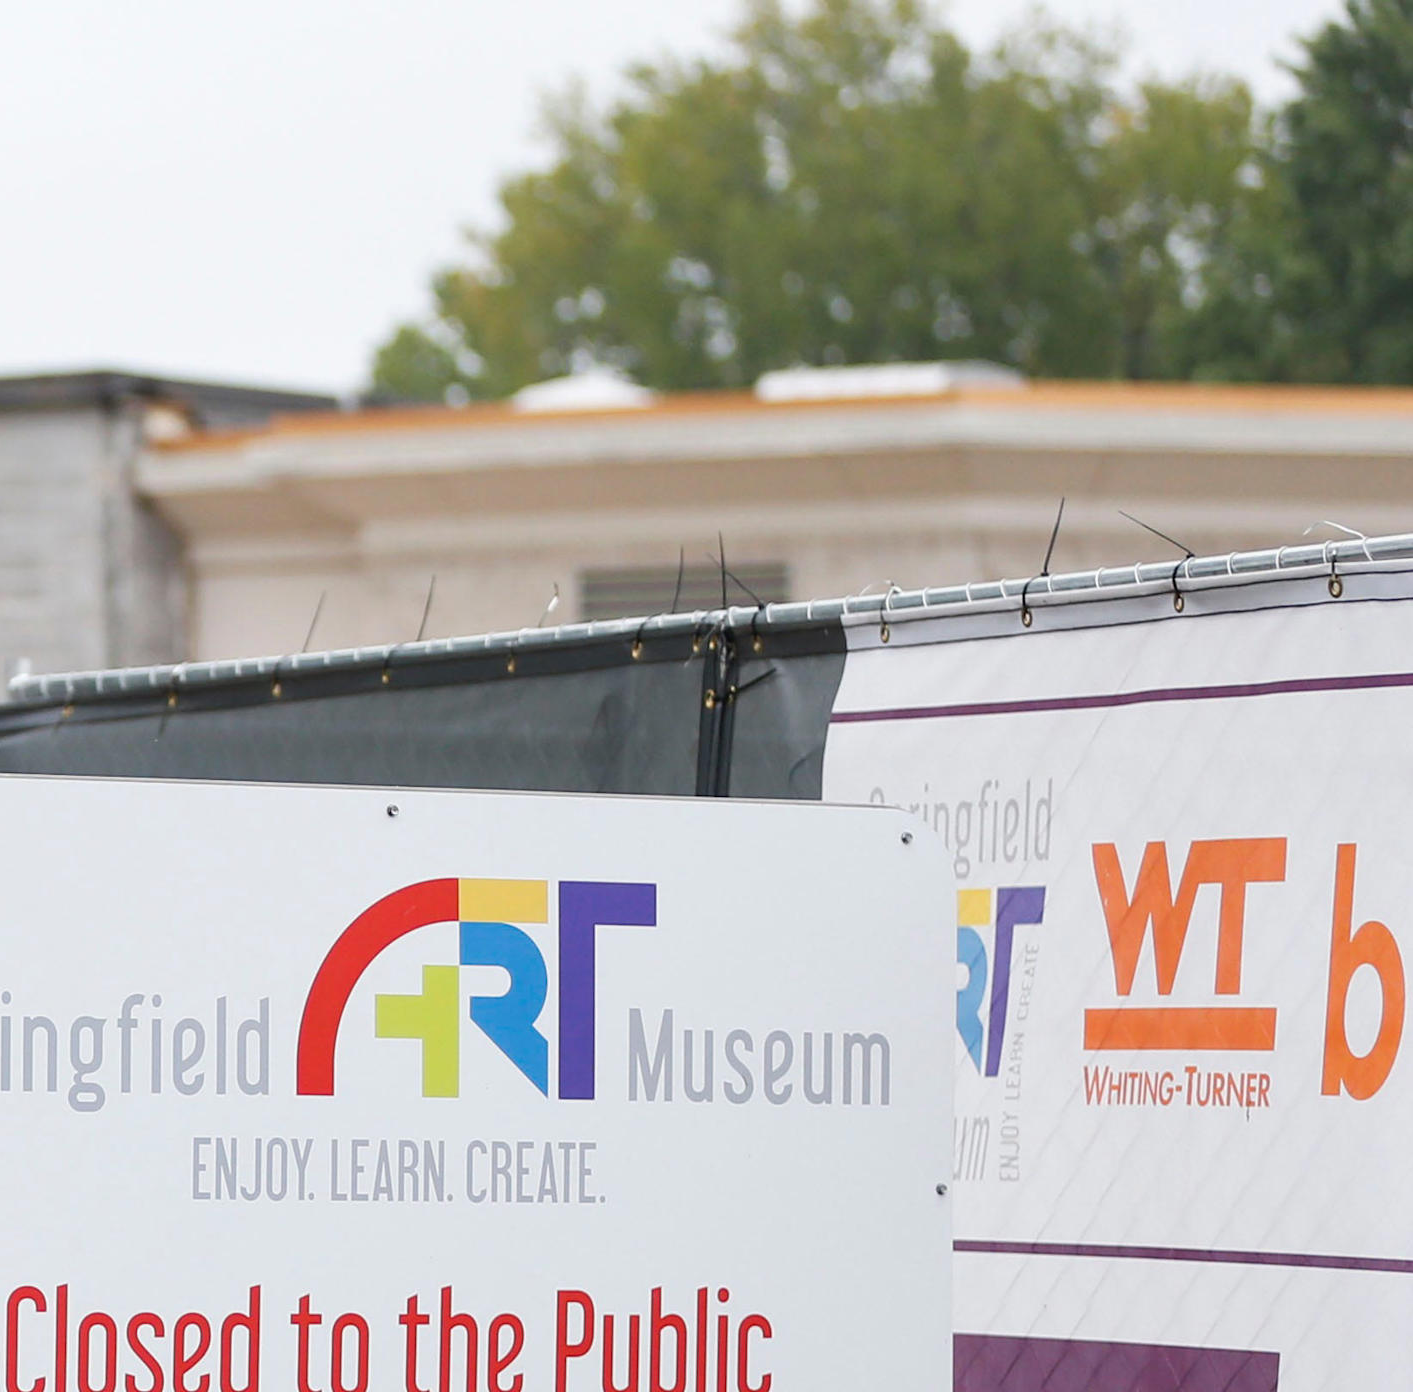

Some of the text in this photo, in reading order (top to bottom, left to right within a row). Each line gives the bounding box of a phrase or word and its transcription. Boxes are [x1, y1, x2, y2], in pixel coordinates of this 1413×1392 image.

[296, 877, 658, 1101] ART
[627, 1007, 892, 1107] Museum
[956, 885, 1046, 1078] RT
[1092, 837, 1288, 996] WT
[998, 942, 1040, 1183] ENJOY LEARN CREATE
[1083, 1065, 1272, 1108] WHITING-TURNER
[191, 1136, 607, 1205] ENJOY. LEARN. CREATE.
